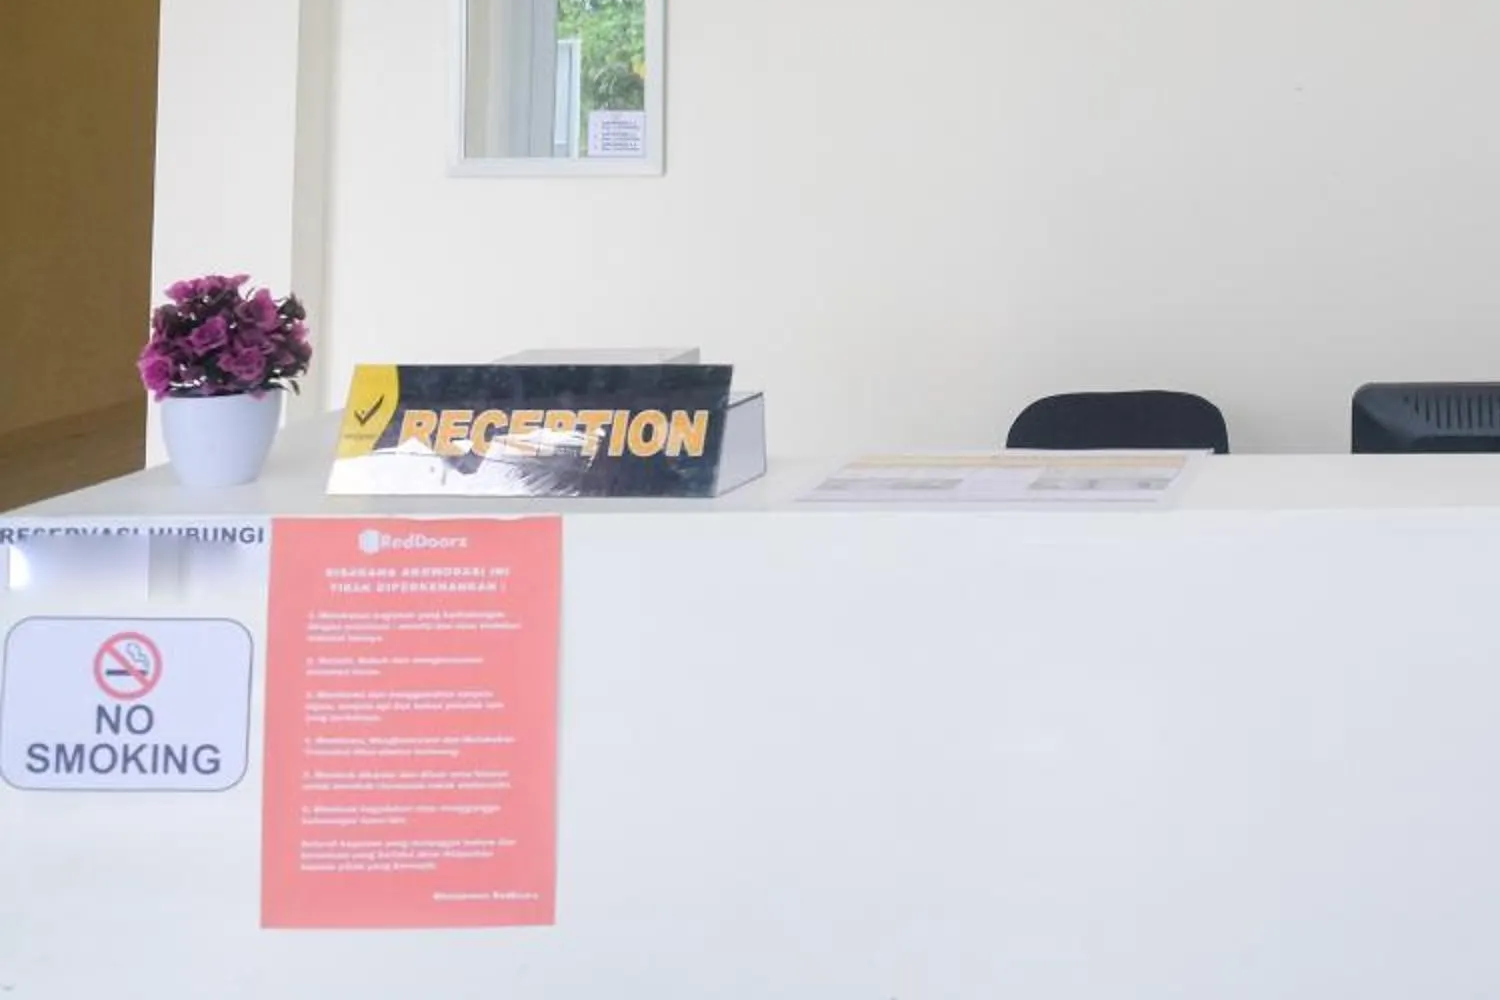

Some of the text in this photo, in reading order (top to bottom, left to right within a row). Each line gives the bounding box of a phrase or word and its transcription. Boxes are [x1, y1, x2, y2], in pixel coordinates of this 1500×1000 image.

[400, 409, 709, 457] RECEPTION
[95, 704, 154, 735] NO
[26, 743, 221, 775] SMOKING
